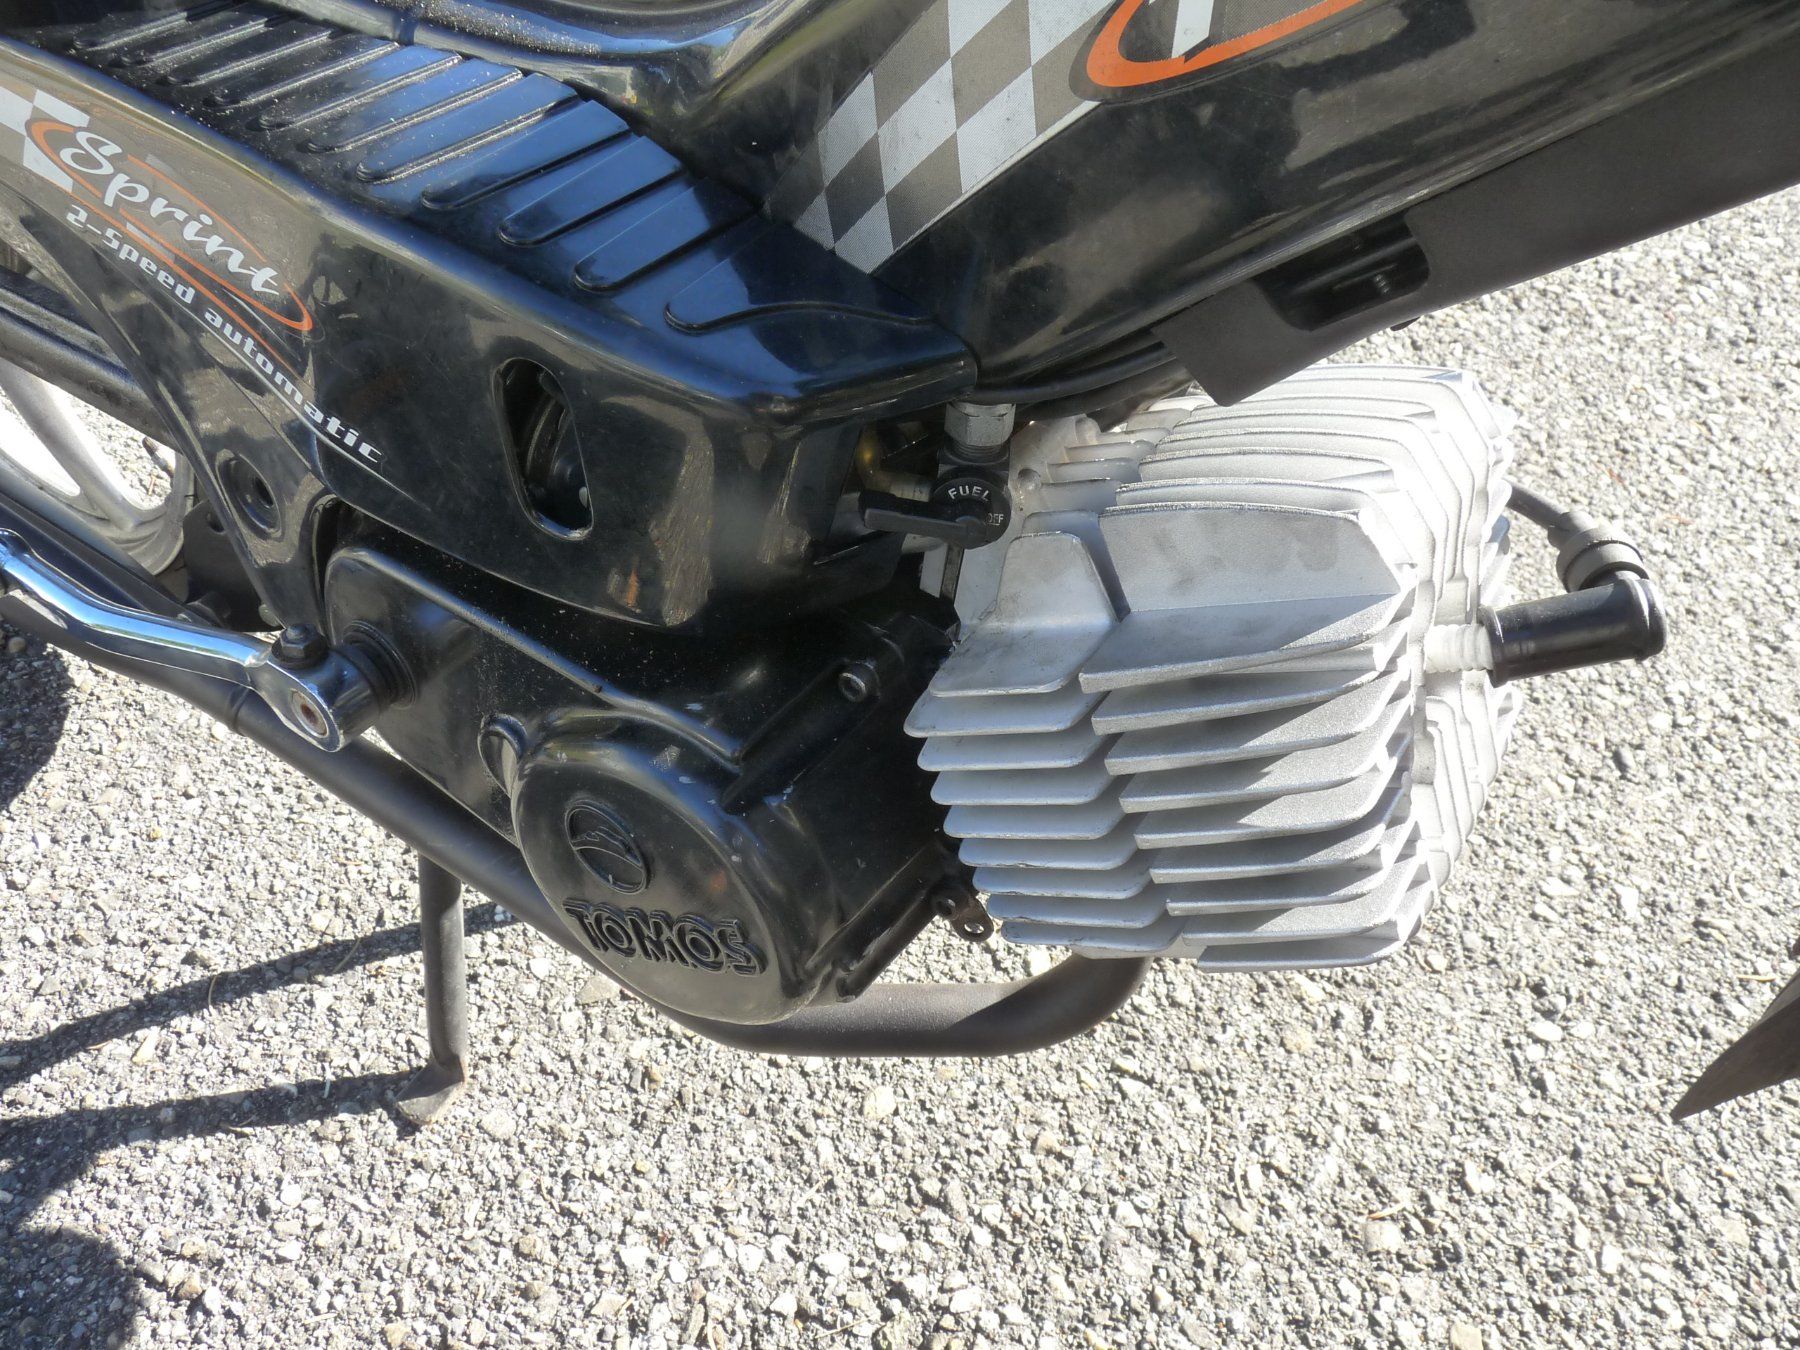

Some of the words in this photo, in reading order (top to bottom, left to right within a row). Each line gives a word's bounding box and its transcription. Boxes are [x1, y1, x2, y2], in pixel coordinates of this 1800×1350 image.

[60, 131, 280, 295] Sprint
[204, 308, 383, 463] automatic
[948, 485, 990, 501] FUEL
[562, 898, 768, 977] TOMOS
